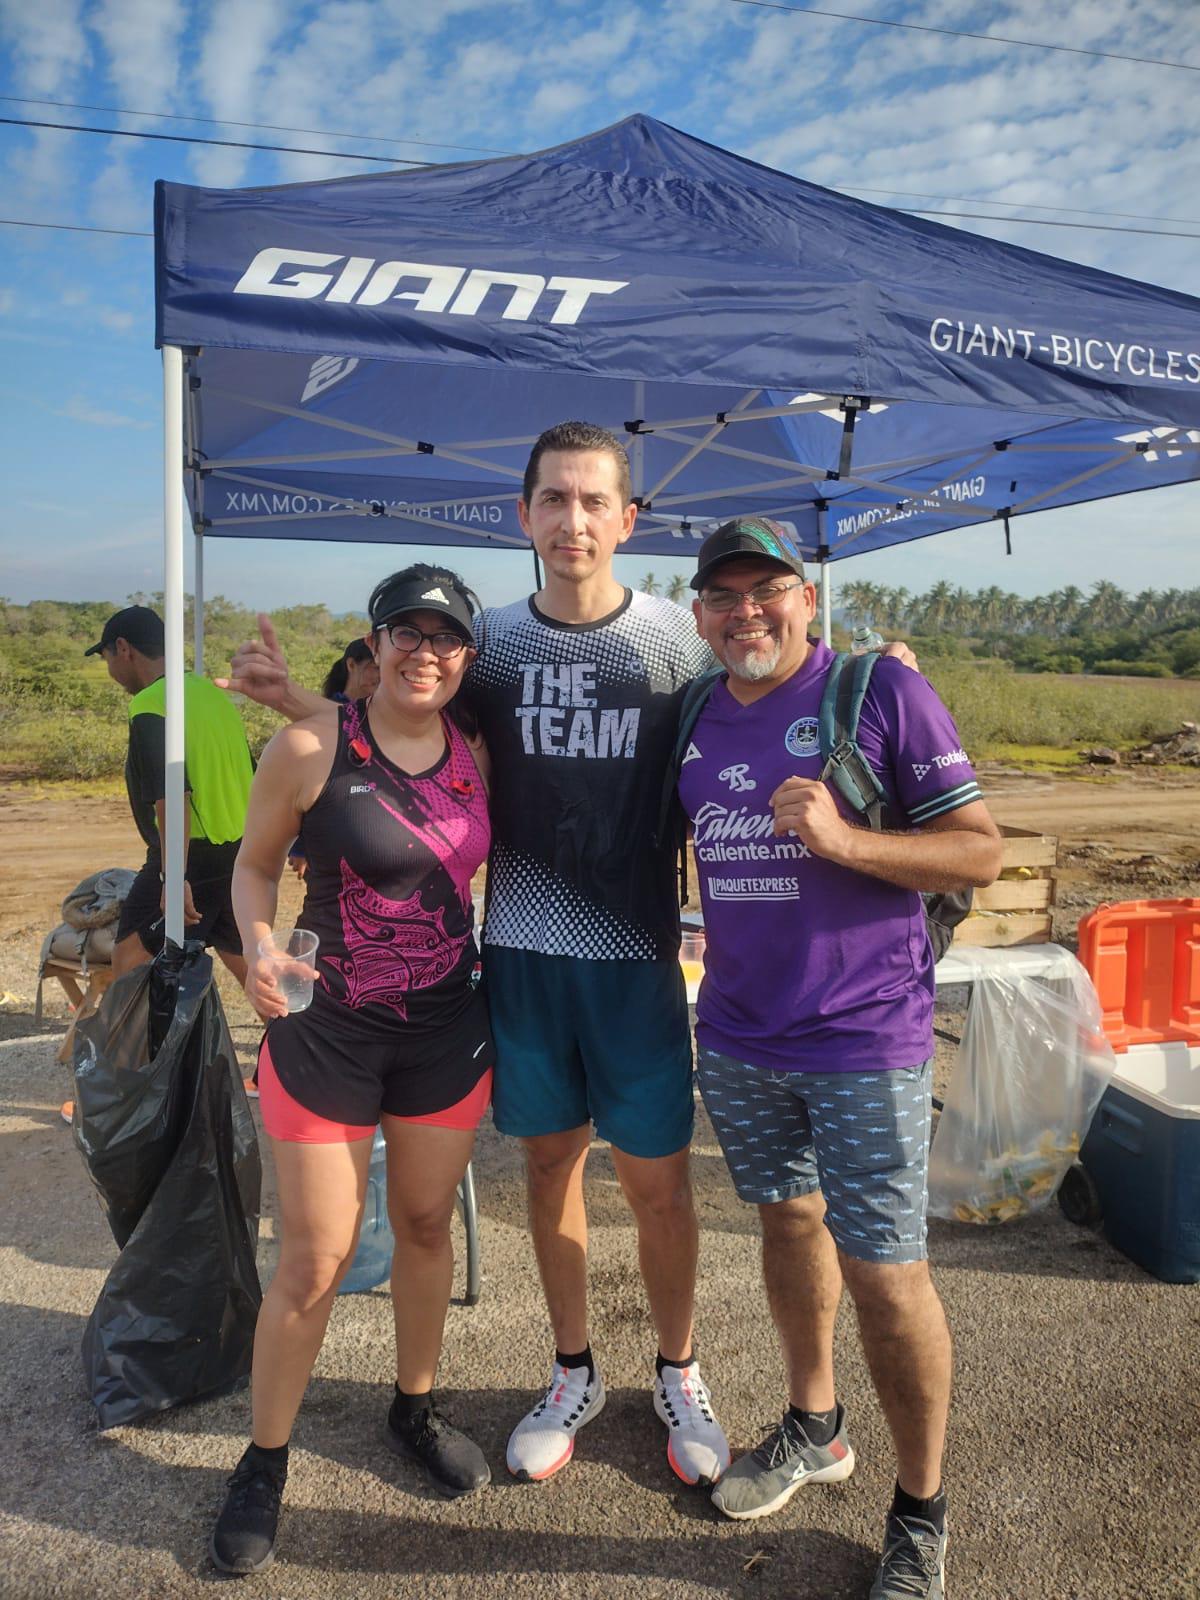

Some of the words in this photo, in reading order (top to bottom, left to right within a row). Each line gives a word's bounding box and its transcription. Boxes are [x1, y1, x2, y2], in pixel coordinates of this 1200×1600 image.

[233, 247, 629, 325] GIANT
[518, 662, 598, 708] THE
[515, 706, 641, 759] TEAM
[691, 801, 798, 846] Calien
[699, 842, 812, 862] caliente.mx
[715, 877, 800, 893] PAQUETEXPRESS
